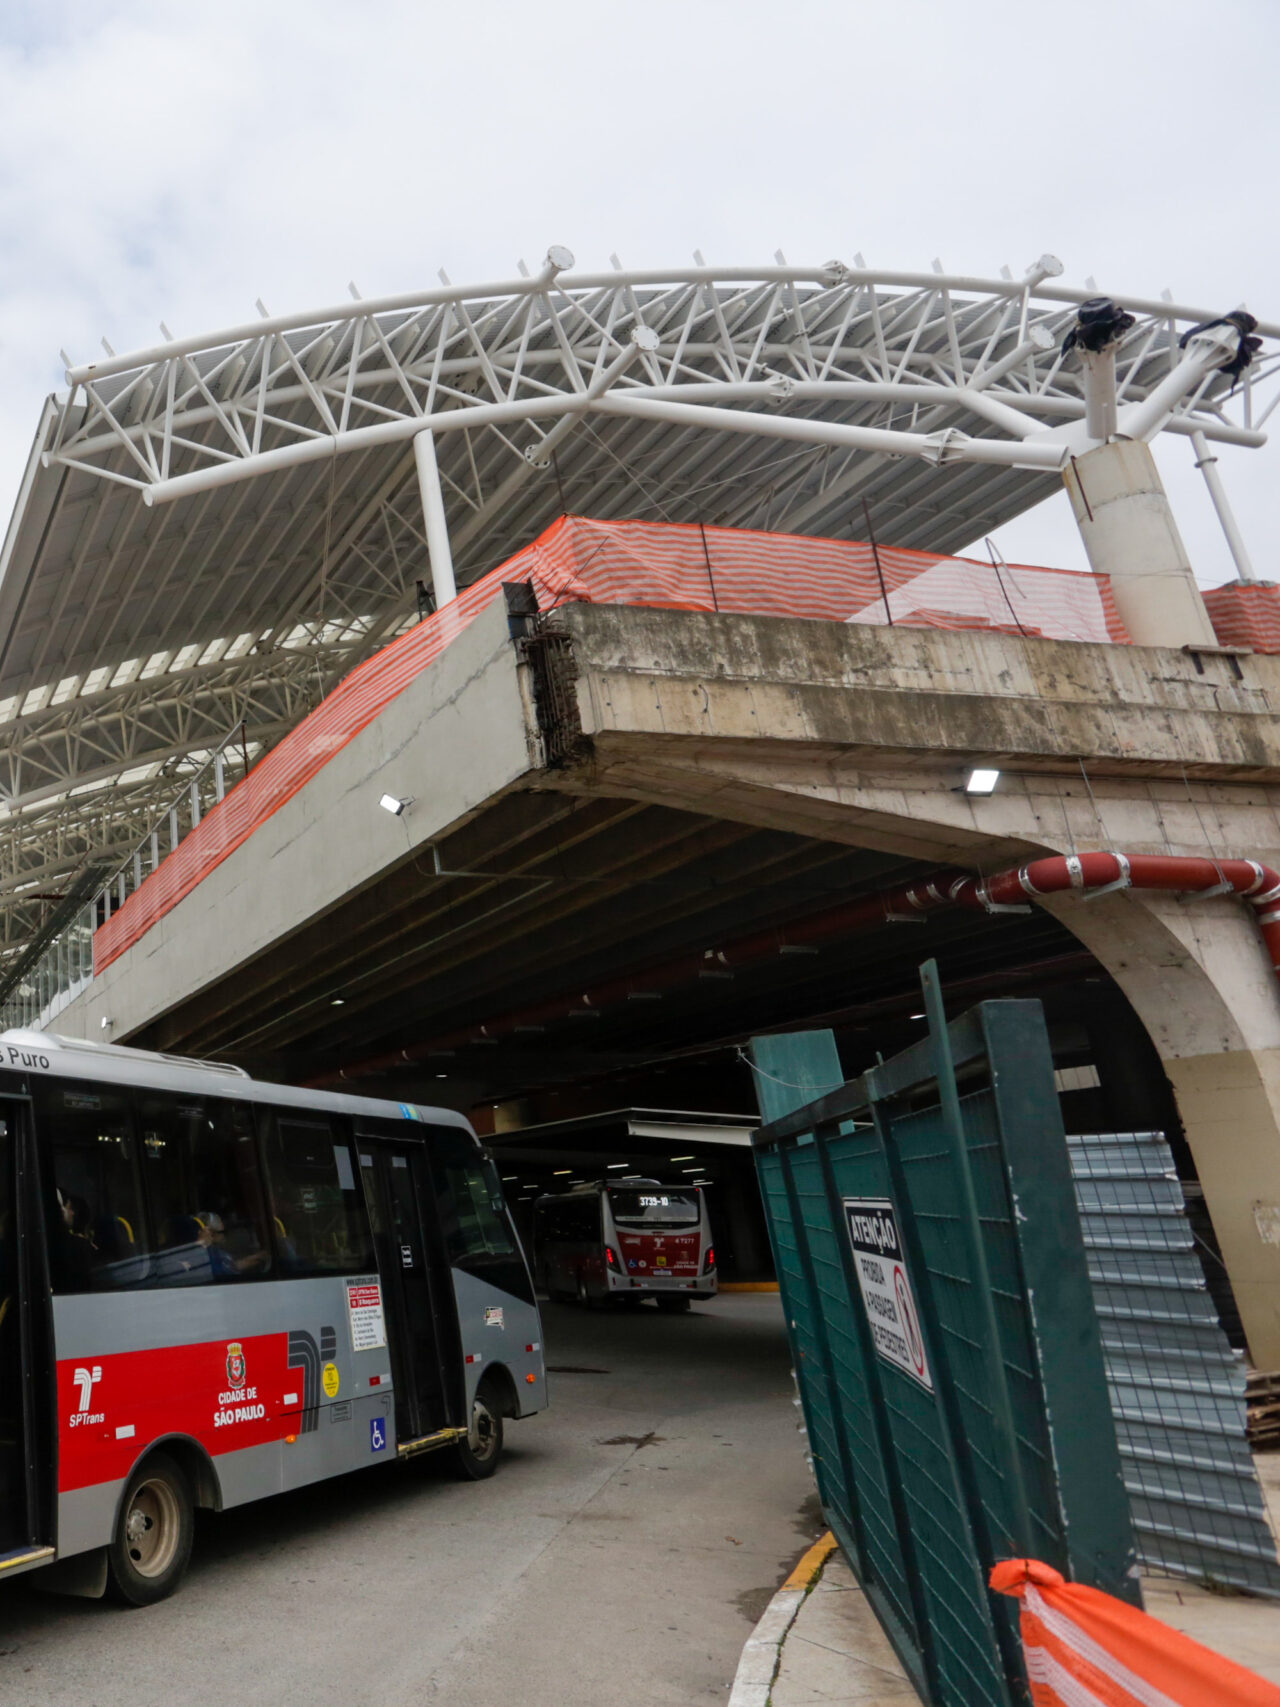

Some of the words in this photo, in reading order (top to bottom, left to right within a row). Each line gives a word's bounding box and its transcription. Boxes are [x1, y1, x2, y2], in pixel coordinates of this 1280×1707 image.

[10, 1047, 50, 1069] Puro
[640, 1197, 669, 1206] 3739-10
[851, 1211, 896, 1254] ATENÇÃO
[218, 1389, 246, 1405] CIDADE
[247, 1387, 257, 1399] DE
[69, 1413, 105, 1428] SPTrans
[214, 1407, 234, 1427] SÃO
[235, 1404, 265, 1423] PAULO
